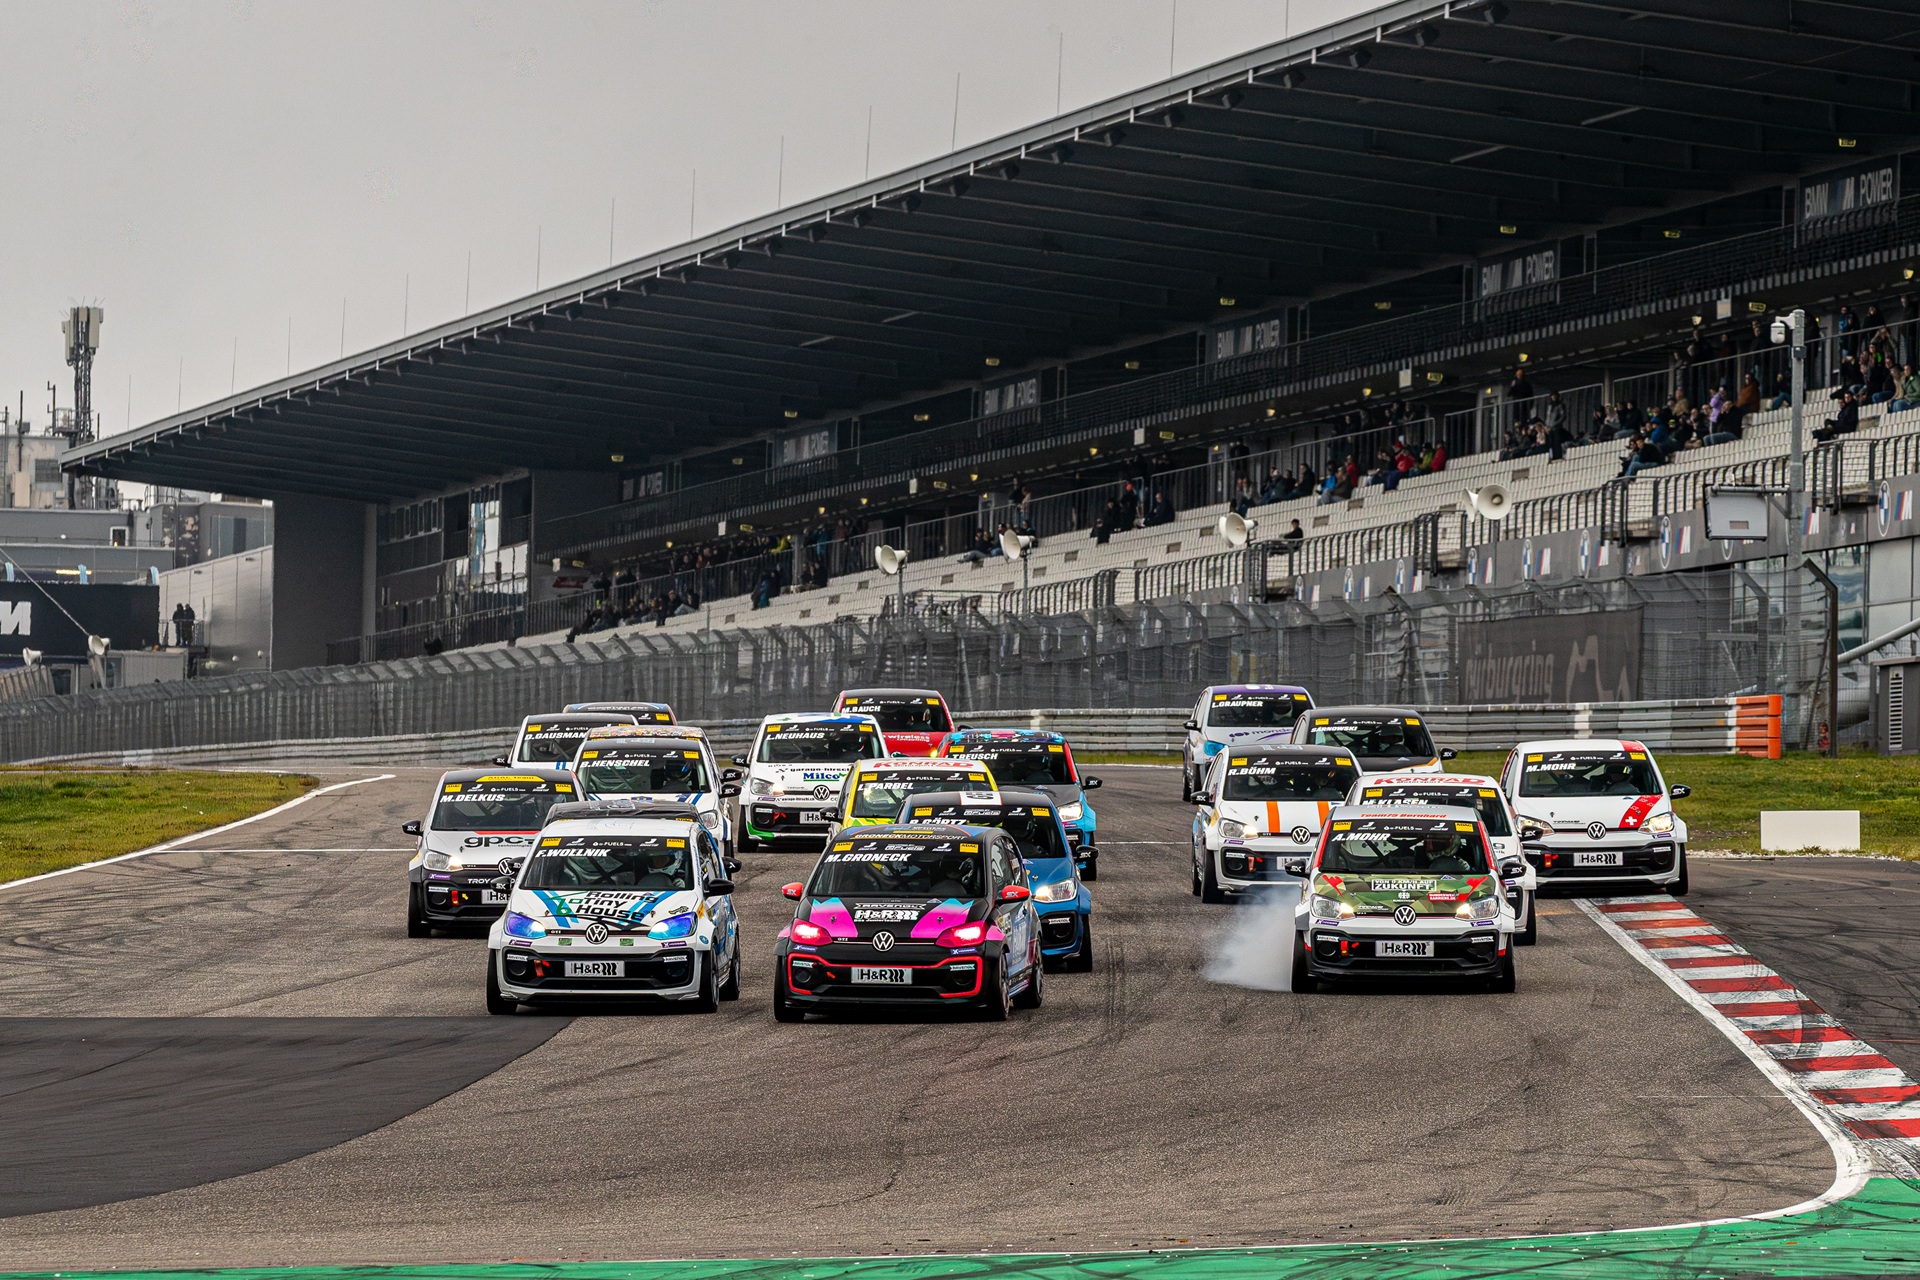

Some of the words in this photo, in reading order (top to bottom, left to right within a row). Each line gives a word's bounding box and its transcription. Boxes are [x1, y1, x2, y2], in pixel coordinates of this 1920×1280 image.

[1860, 168, 1893, 206] POWER
[766, 732, 825, 740] L.NEUHAUS
[580, 760, 650, 768] B.HENSCHEL
[1526, 763, 1577, 772] M.MOHR
[1228, 767, 1276, 776] R.BÖHM
[1374, 777, 1486, 785] KONRAD
[440, 794, 506, 803] M.DELKUS
[1332, 833, 1391, 842] A.MOHR
[535, 848, 611, 858] F.WOLLNIK
[824, 853, 912, 863] M.GRONECK
[1581, 854, 1604, 864] H&R
[586, 892, 659, 903] Rolling
[584, 898, 628, 908] Tiny
[576, 905, 645, 919] House
[1385, 942, 1411, 954] H&R
[573, 963, 601, 975] H&R
[860, 969, 888, 981] H&R
